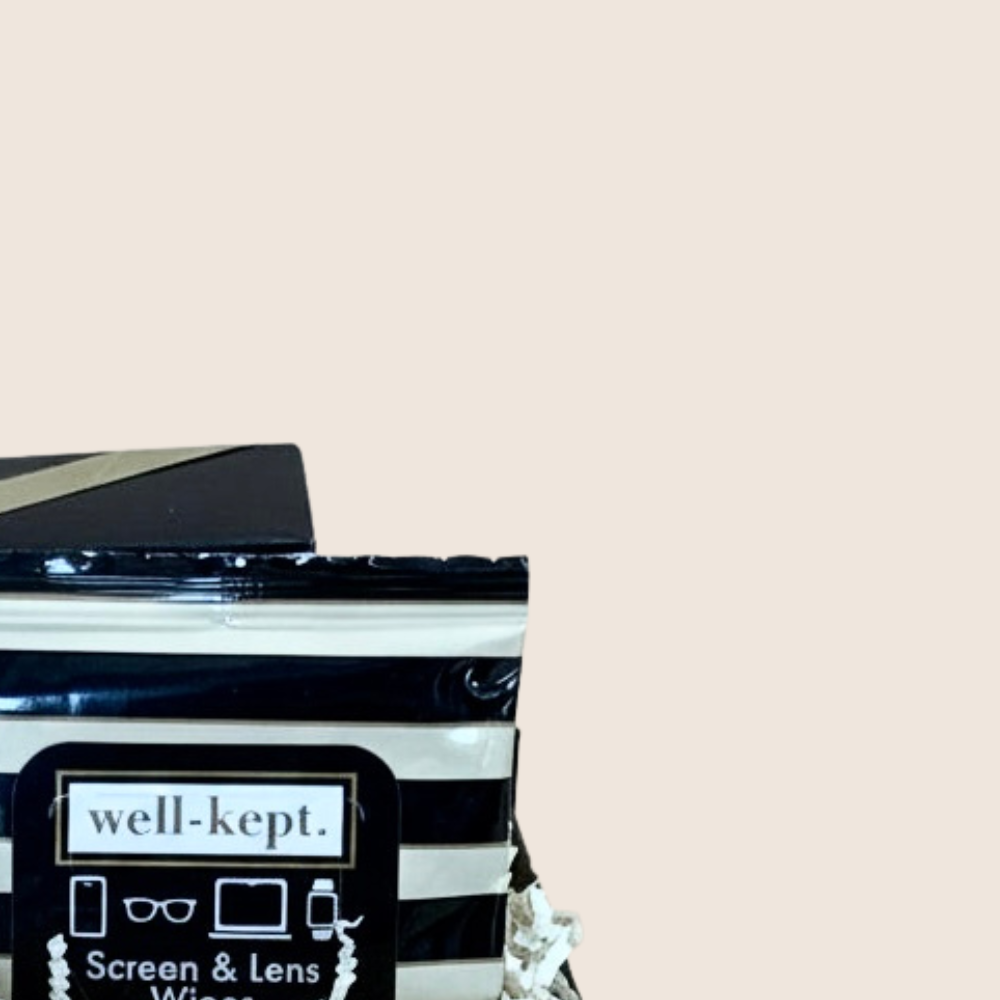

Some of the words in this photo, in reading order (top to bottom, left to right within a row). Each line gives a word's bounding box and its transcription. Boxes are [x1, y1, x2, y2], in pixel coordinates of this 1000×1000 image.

[88, 795, 327, 850] well-kept.
[85, 950, 199, 982] Screen
[211, 951, 238, 984] &
[250, 952, 321, 984] Lens
